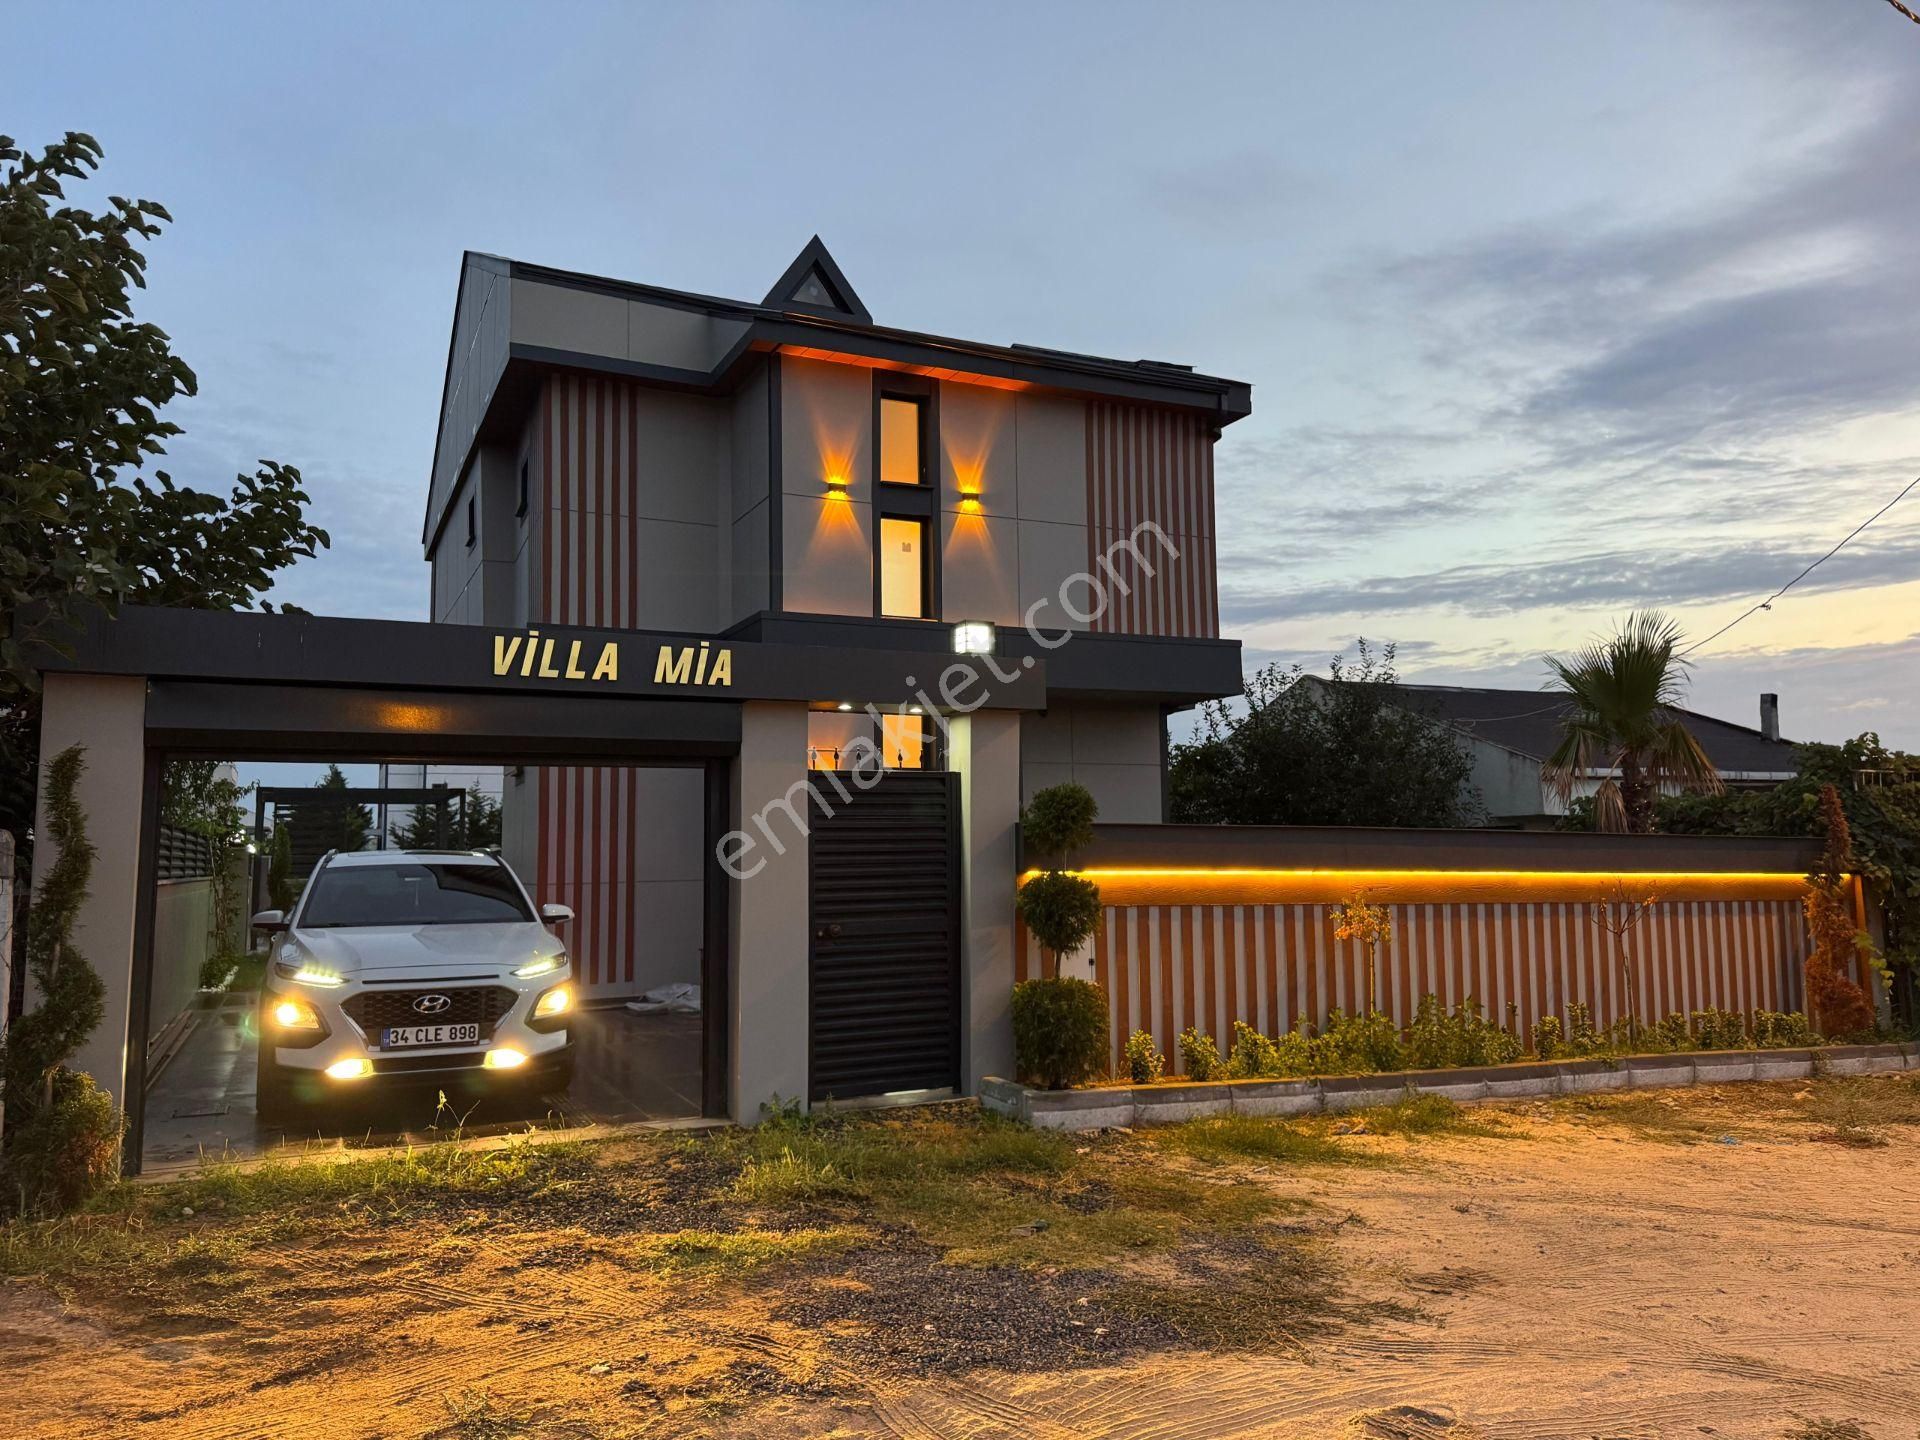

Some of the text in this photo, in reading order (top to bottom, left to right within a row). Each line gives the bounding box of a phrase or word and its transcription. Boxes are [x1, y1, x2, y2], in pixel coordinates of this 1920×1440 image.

[494, 630, 732, 686] VİLLA MİA
[391, 1025, 476, 1044] 34 CLE 898
